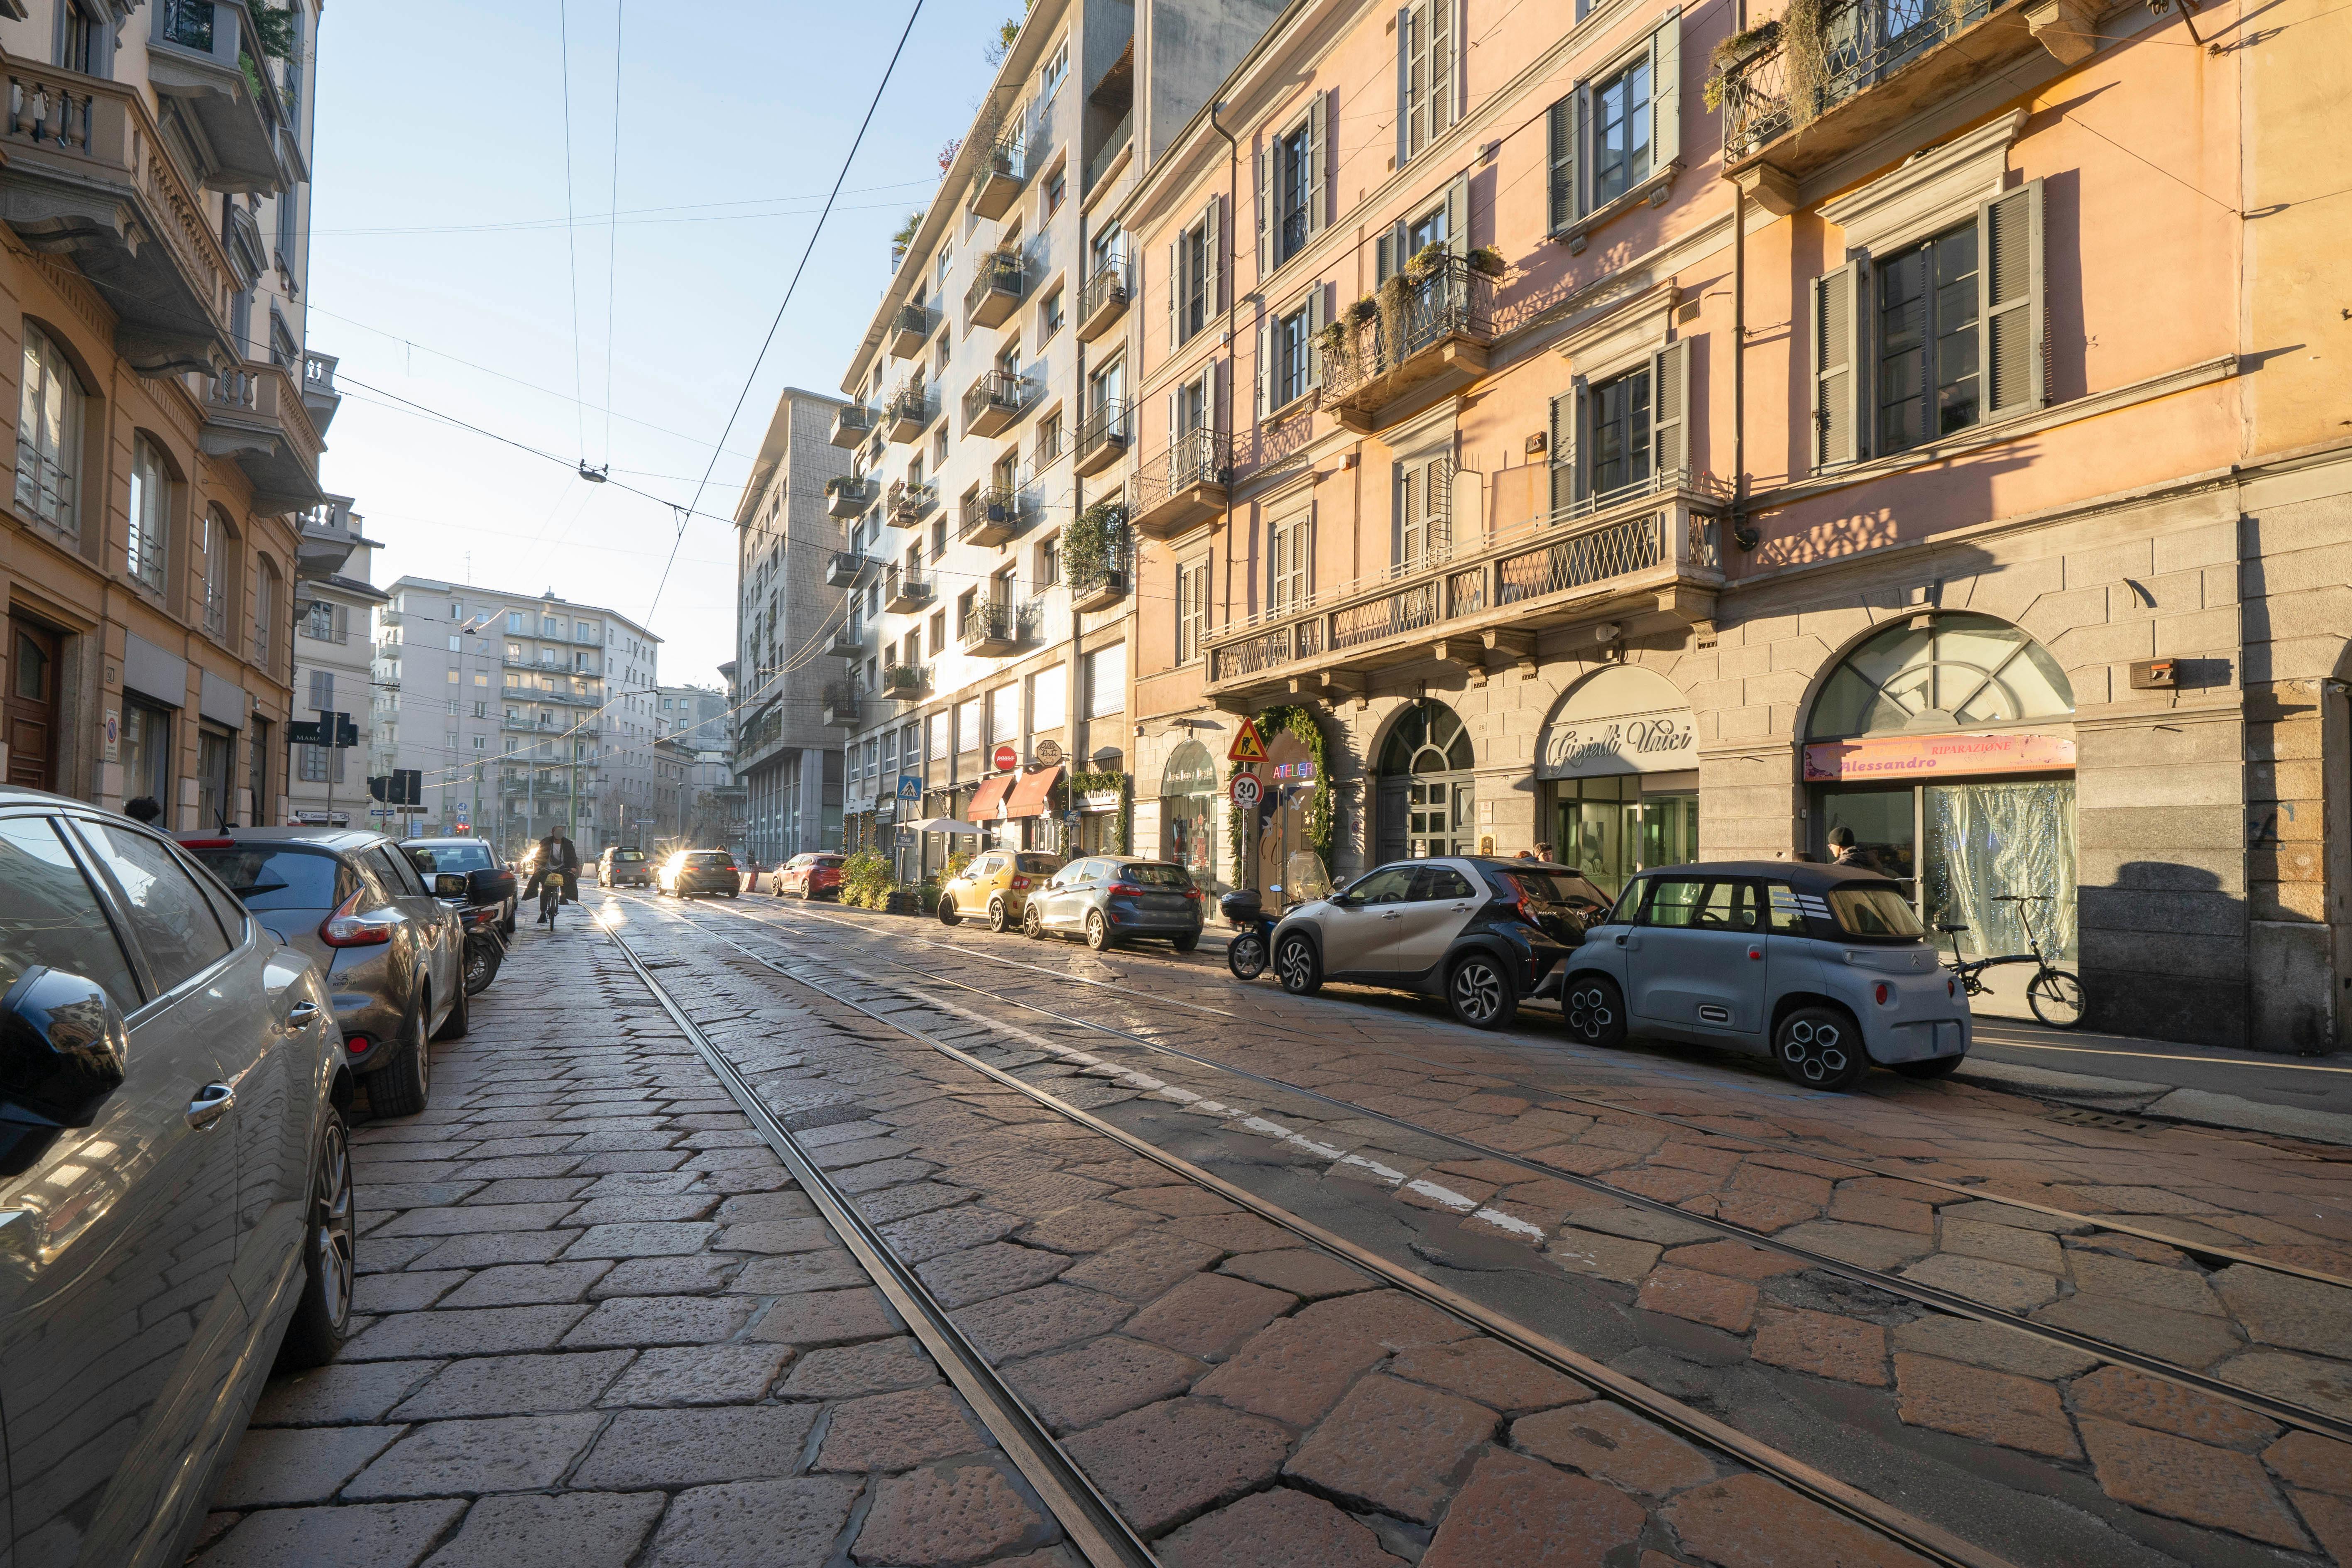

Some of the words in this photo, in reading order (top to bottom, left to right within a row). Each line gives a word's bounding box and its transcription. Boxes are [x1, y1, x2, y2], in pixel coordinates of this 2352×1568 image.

[1039, 742, 1056, 751] Belle
[1546, 724, 1622, 775] Gioielli
[1625, 719, 1692, 753] Unici
[1931, 741, 2012, 755] RIPARAZIONE
[1273, 762, 1312, 779] ATELIER
[1838, 757, 1936, 772] Alessandro
[1238, 782, 1256, 798] 30
